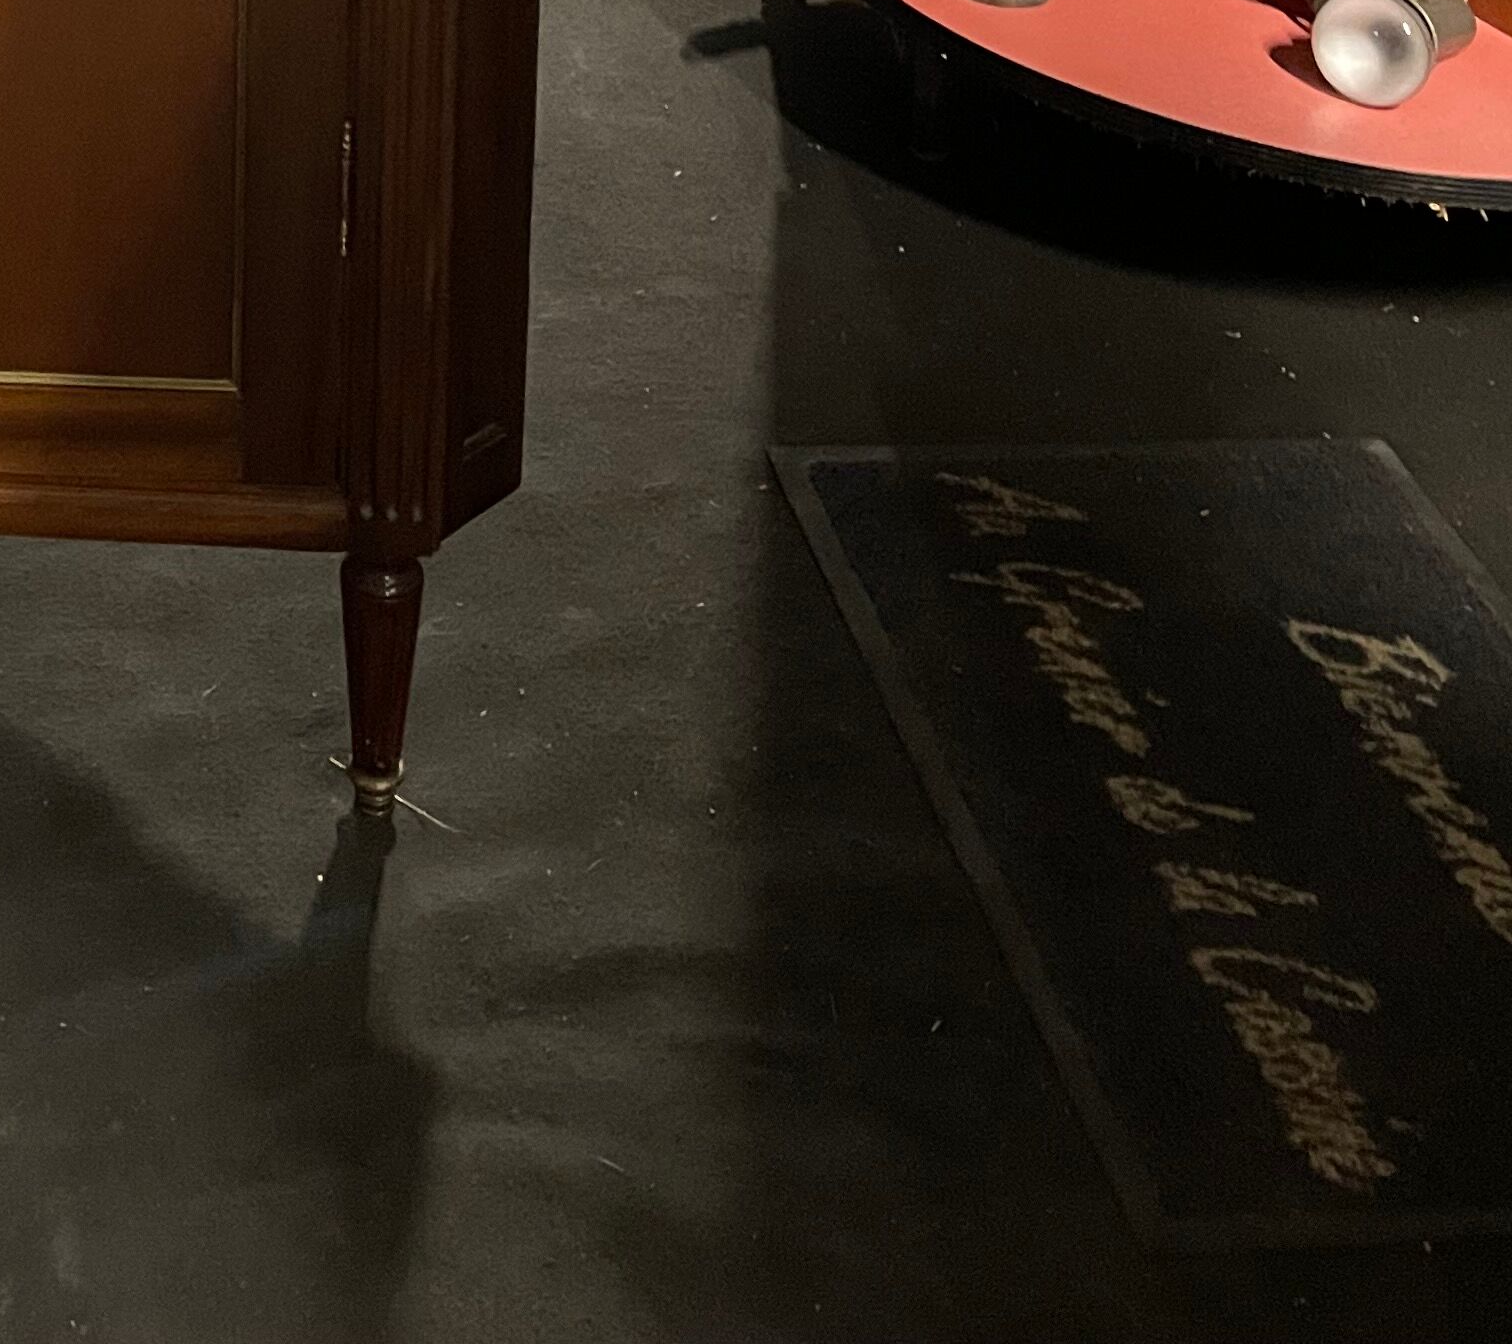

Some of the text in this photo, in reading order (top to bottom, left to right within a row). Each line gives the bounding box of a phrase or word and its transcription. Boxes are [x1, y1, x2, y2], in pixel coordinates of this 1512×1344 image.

[936, 471, 1088, 537] Au
[948, 562, 1171, 758] Grenier
[1106, 774, 1256, 834] de
[1152, 860, 1319, 917] la
